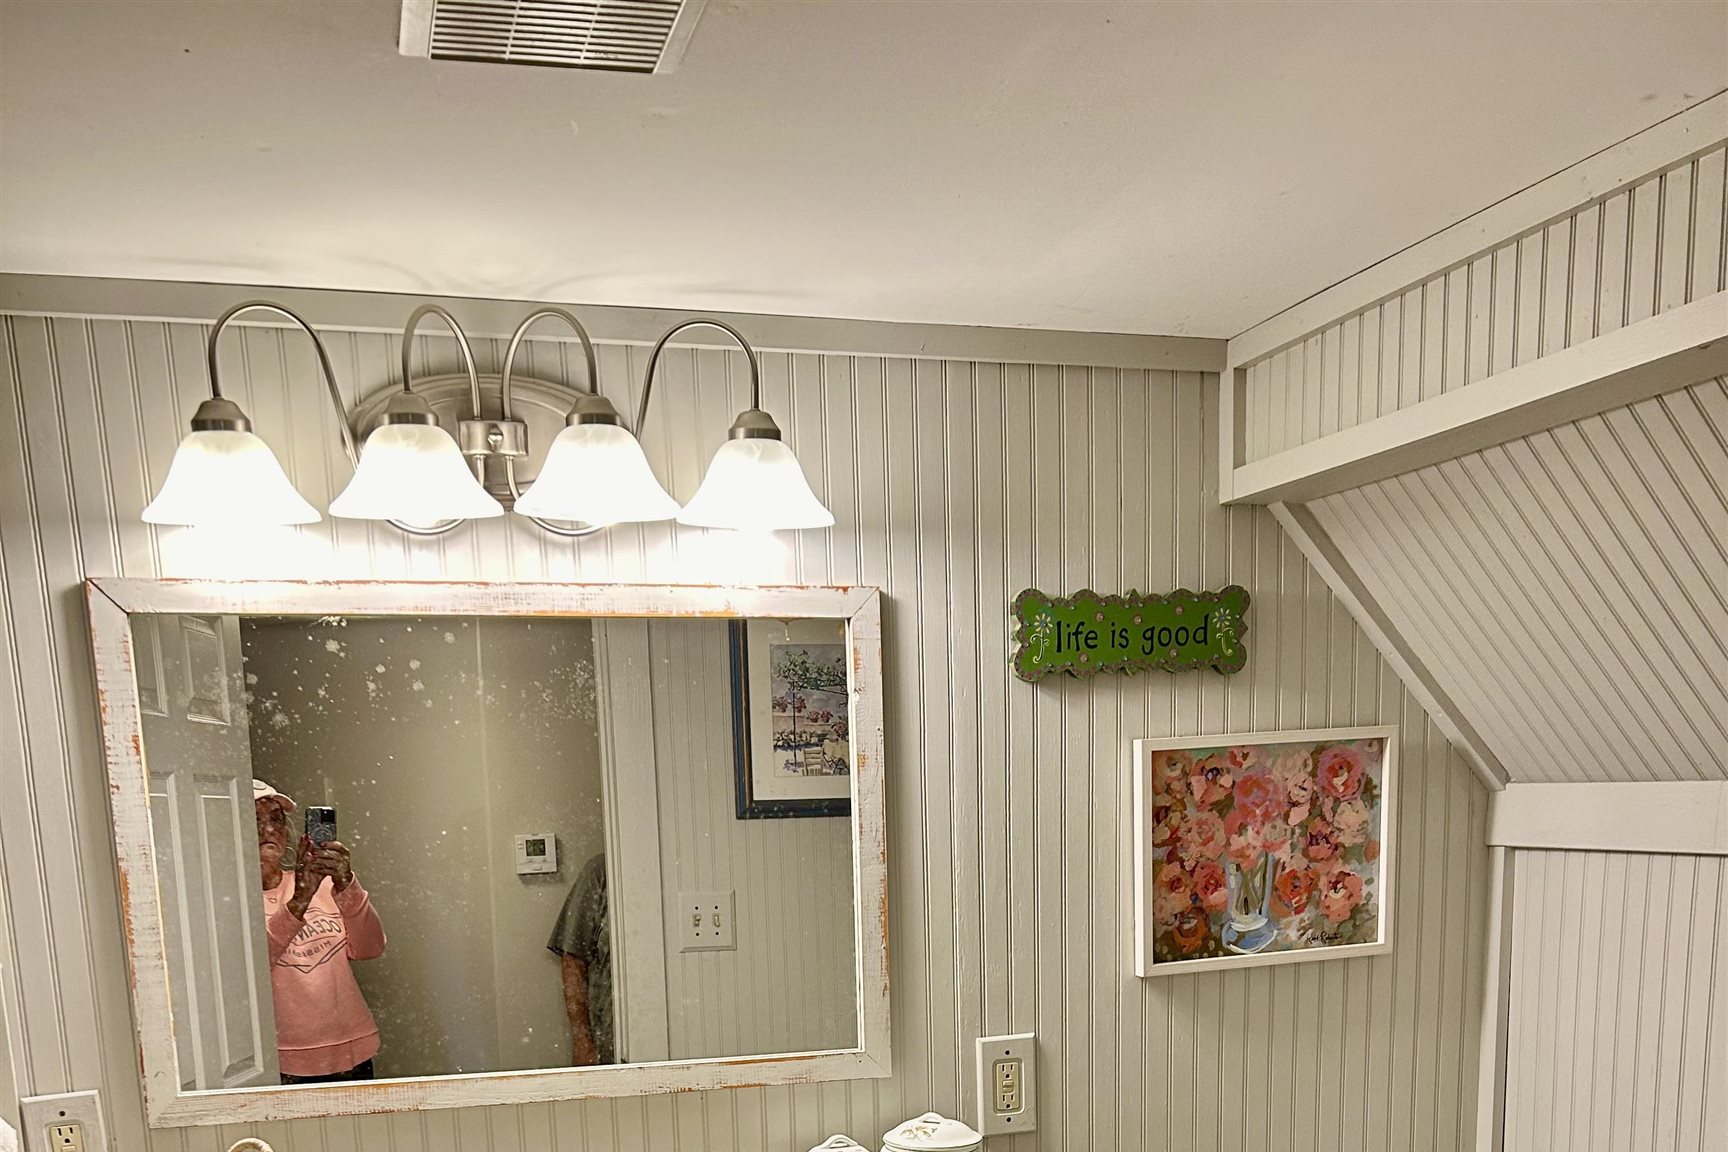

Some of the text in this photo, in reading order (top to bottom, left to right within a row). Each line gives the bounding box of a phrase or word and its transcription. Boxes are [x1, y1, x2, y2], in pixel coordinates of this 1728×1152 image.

[1056, 613, 1210, 656] life is good
